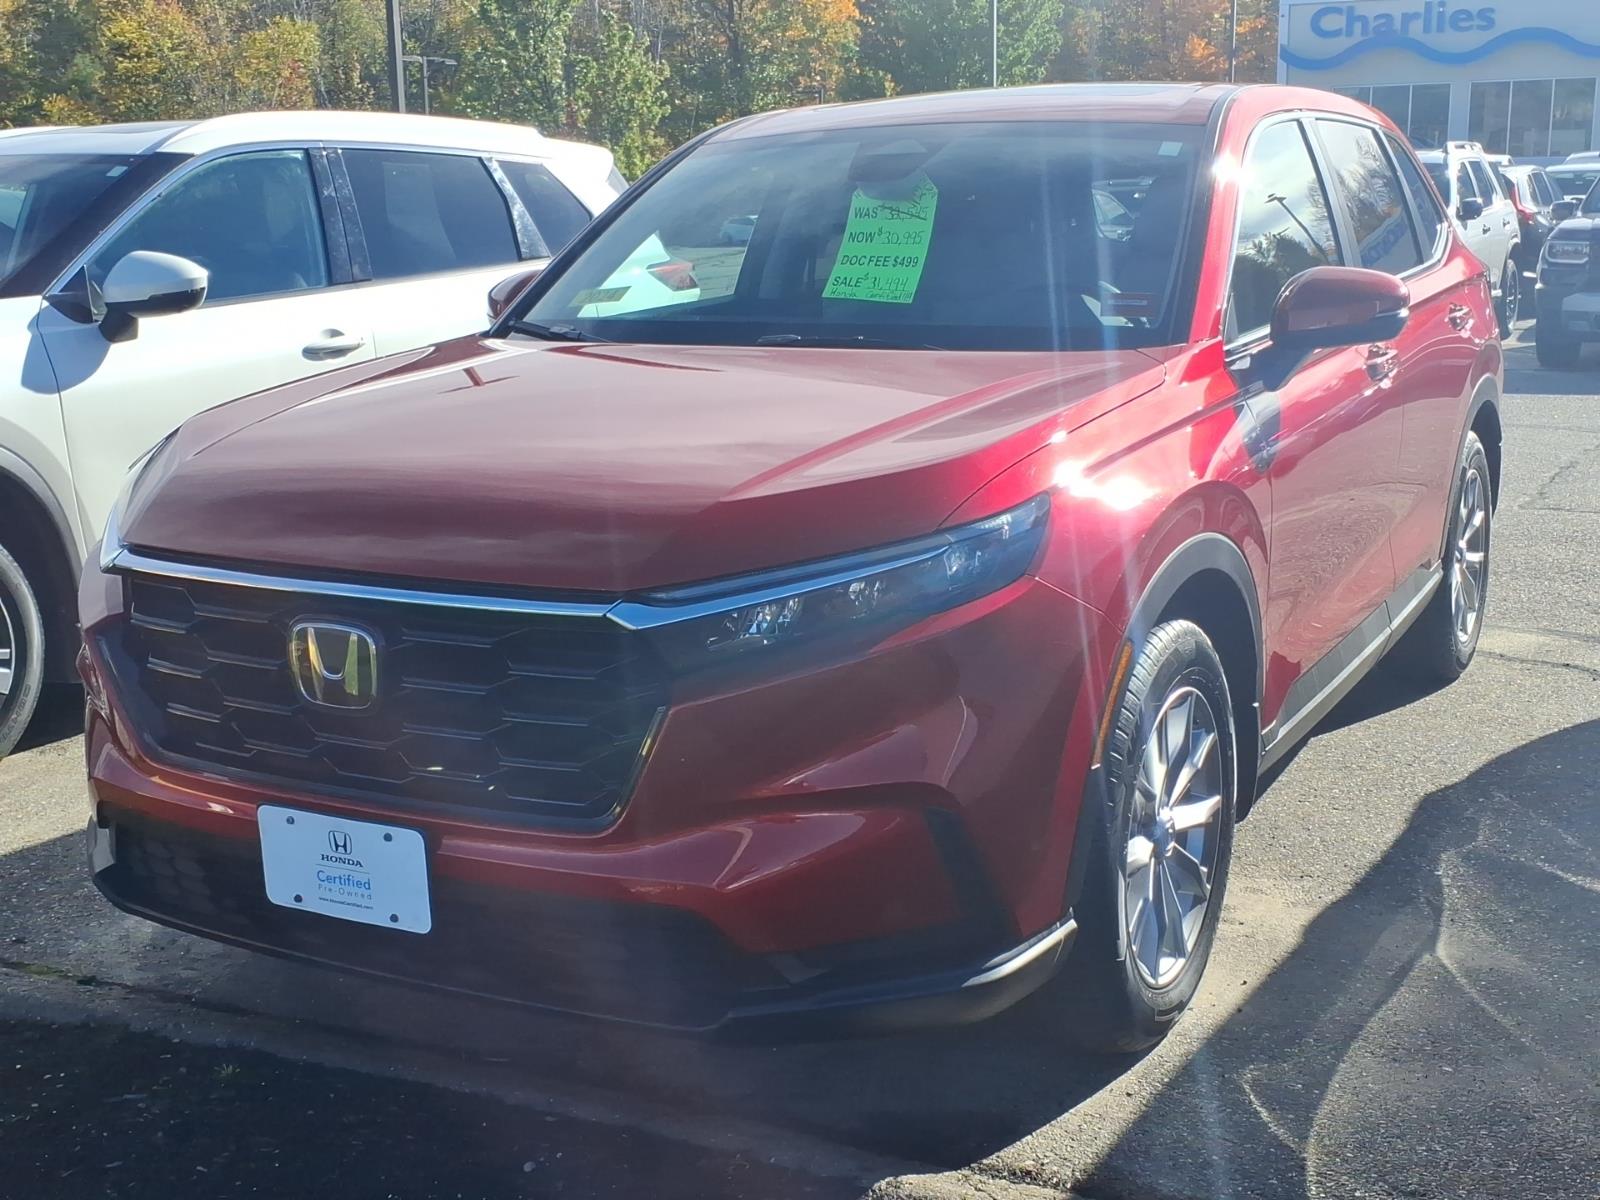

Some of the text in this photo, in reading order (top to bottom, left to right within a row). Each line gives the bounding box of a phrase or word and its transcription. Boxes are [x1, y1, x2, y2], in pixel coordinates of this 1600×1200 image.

[1310, 1, 1496, 39] Charlies
[854, 206, 878, 219] WAS
[847, 231, 876, 243] NOW
[840, 255, 919, 268] DOC FEE $499
[832, 276, 863, 288] SALE
[320, 854, 363, 867] HONDA
[316, 870, 371, 890] Certified
[318, 883, 372, 900] Pre-Owned
